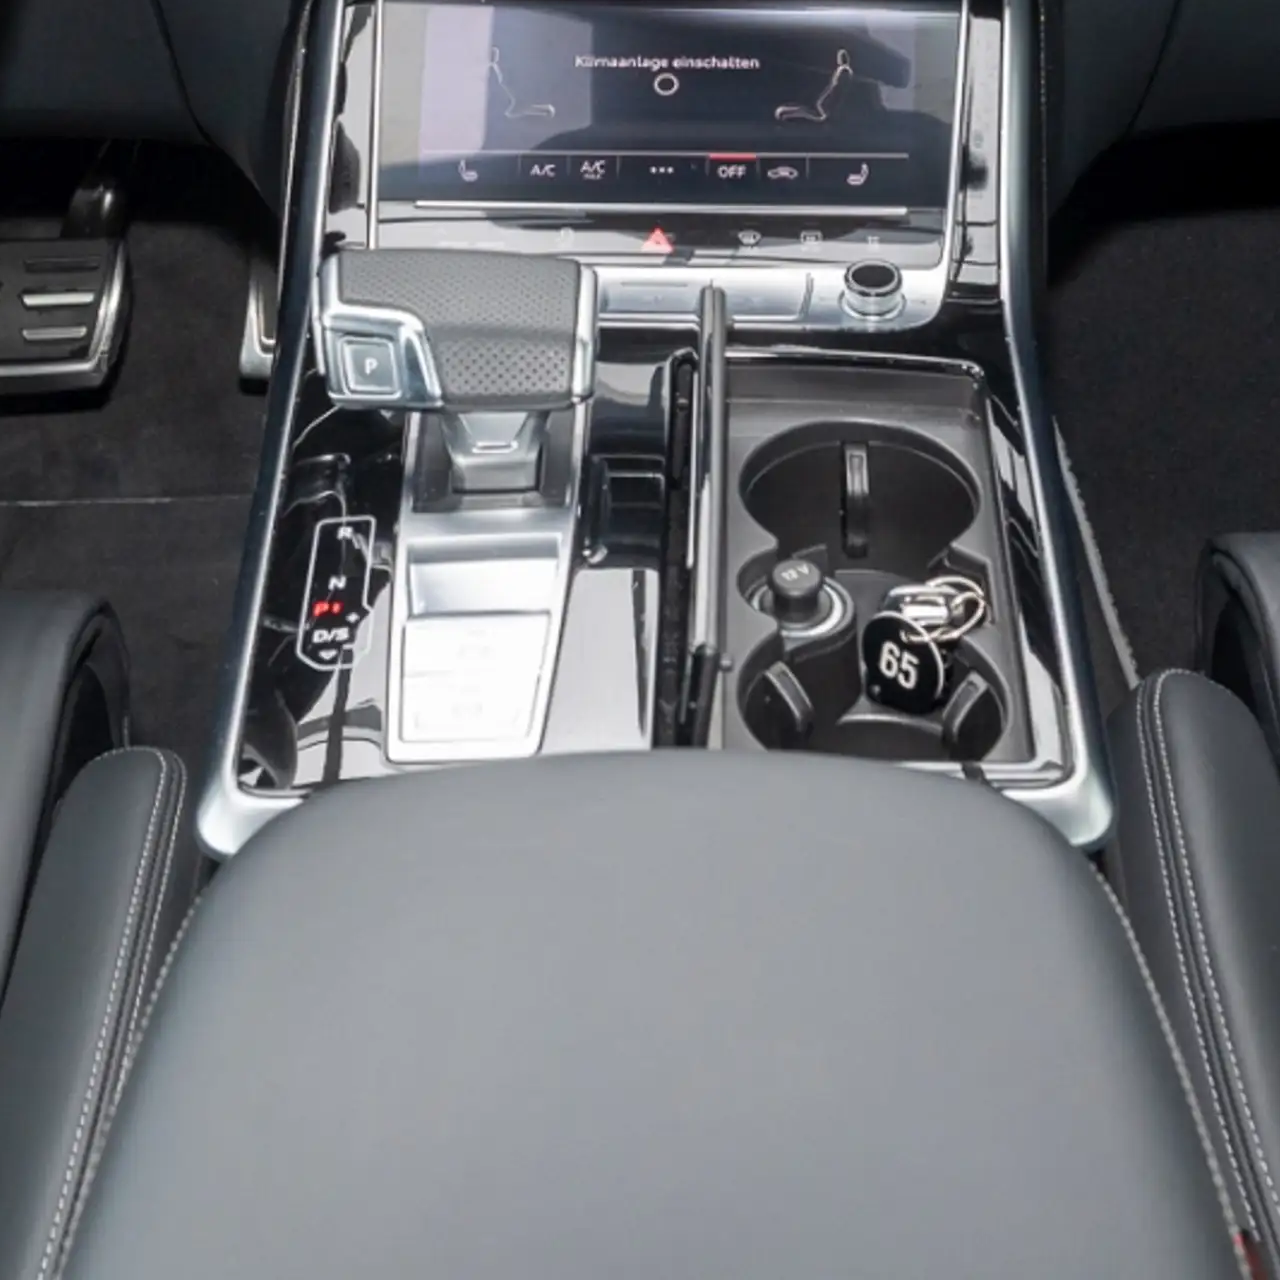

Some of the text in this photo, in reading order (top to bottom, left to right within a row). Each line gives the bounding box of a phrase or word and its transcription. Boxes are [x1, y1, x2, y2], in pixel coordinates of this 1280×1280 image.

[573, 55, 762, 72] Klimaanlage einschalten
[529, 163, 557, 178] A/C
[580, 158, 606, 173] A/C
[717, 164, 747, 179] OFF
[364, 356, 379, 376] P
[336, 525, 354, 541] R
[327, 575, 348, 592] N
[312, 601, 330, 617] P
[311, 626, 350, 644] D/S
[878, 640, 920, 691] 65
